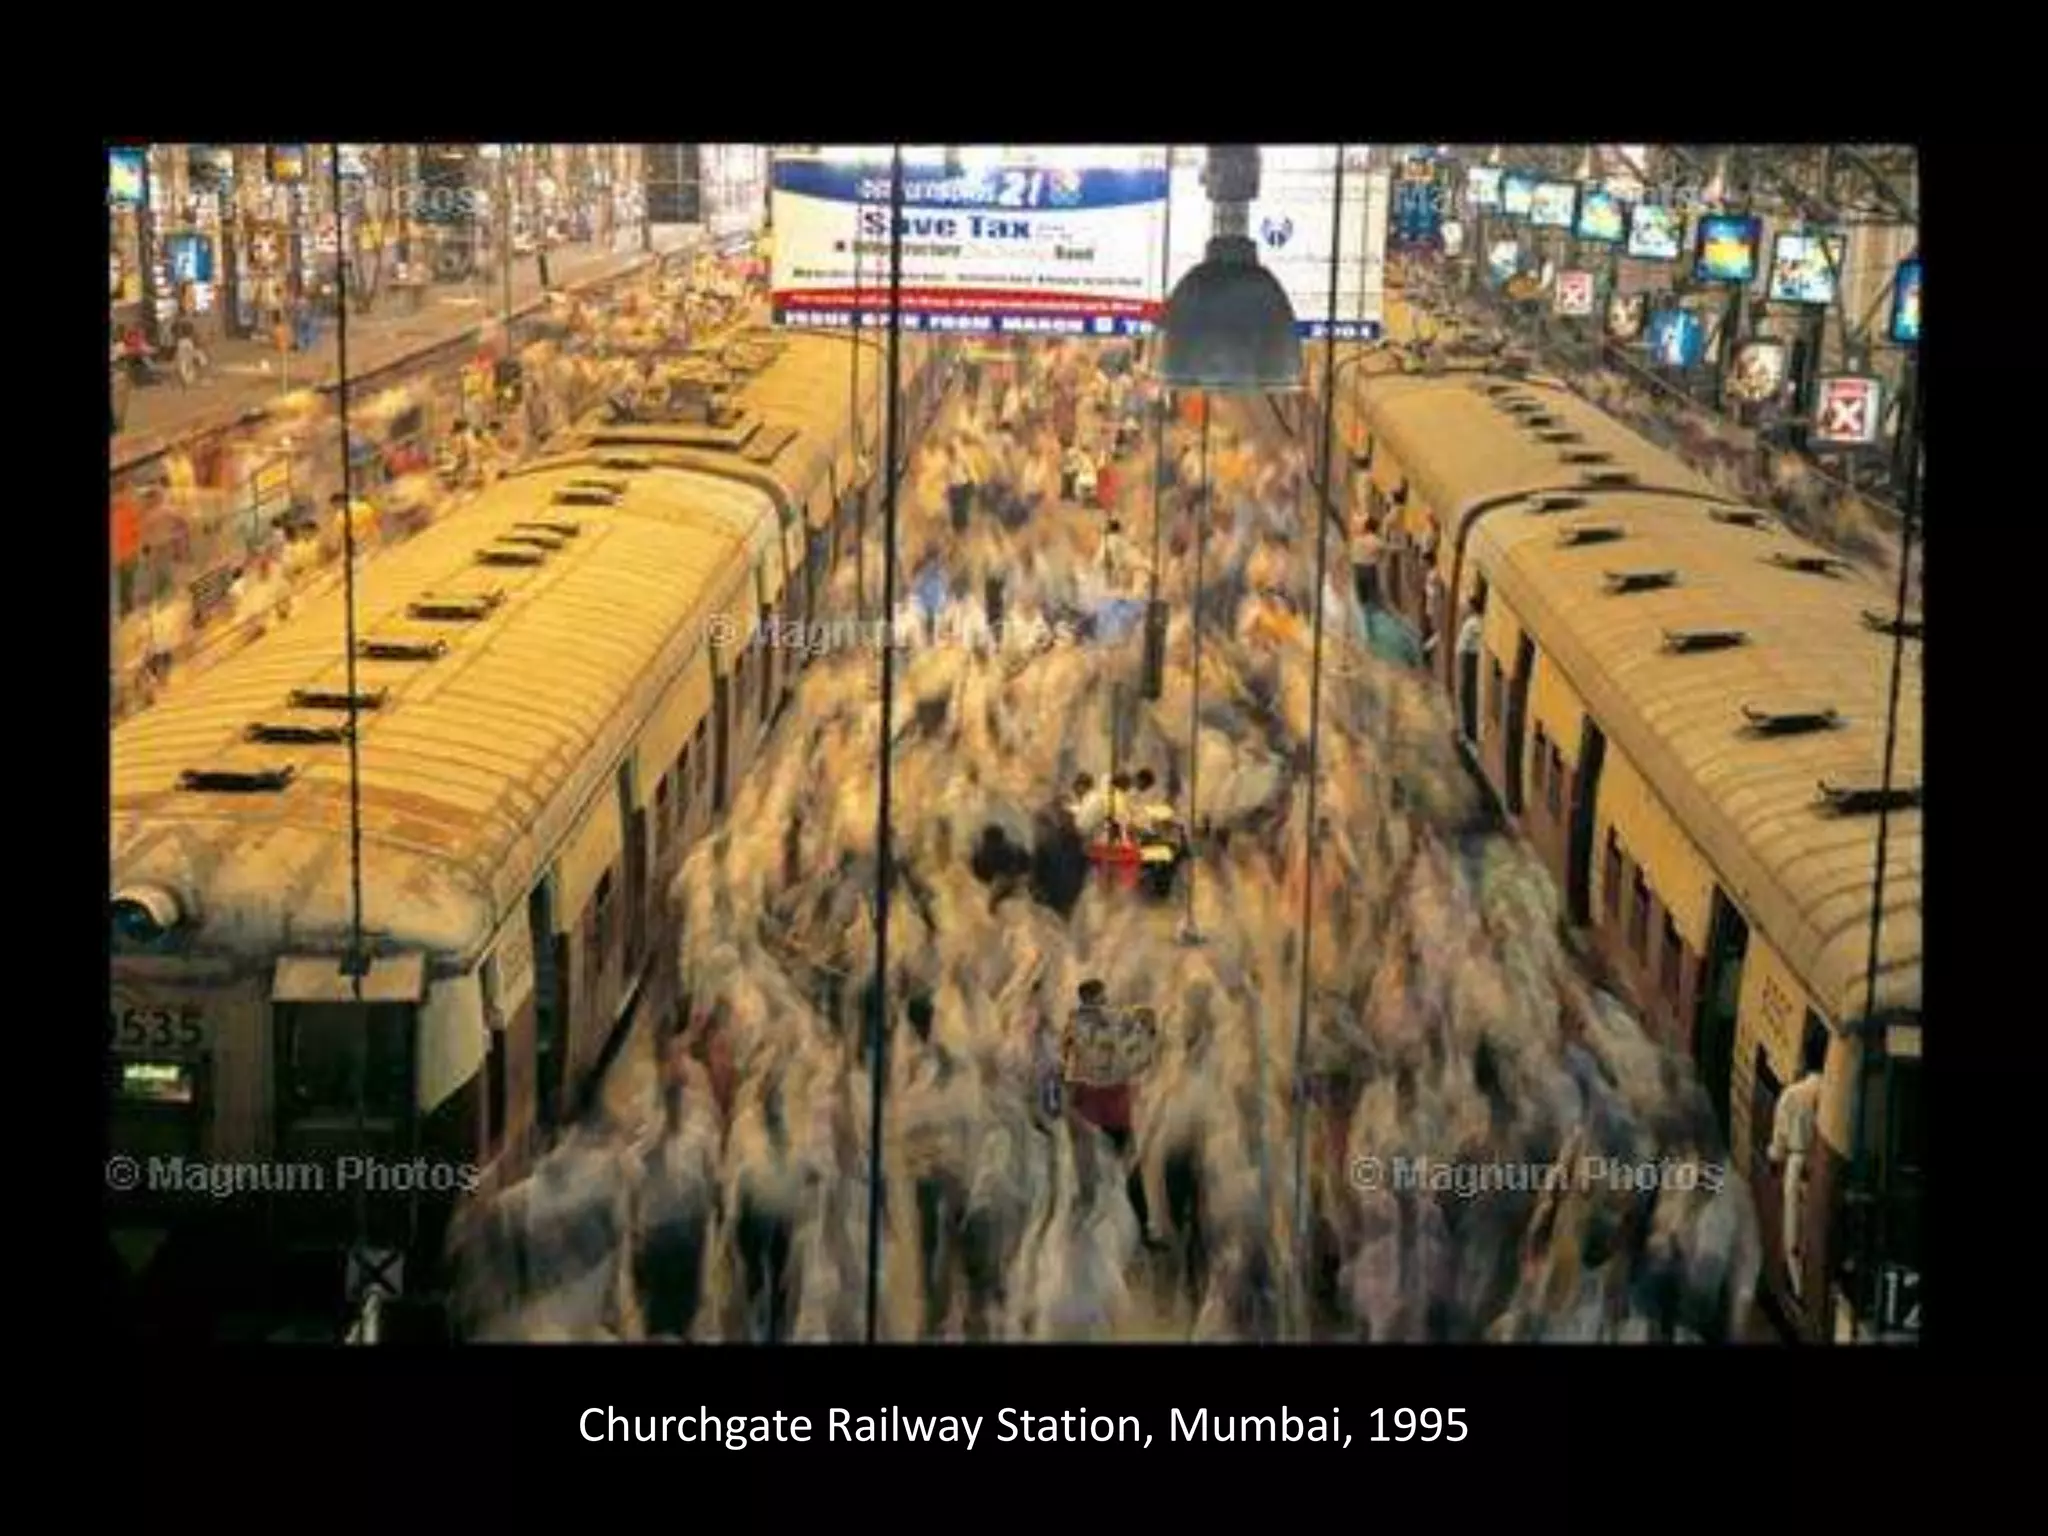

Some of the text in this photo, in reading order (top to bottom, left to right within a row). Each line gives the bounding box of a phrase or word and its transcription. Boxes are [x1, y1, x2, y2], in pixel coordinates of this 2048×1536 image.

[968, 215, 1029, 239] Tax
[860, 311, 920, 328] OPN
[929, 314, 992, 330] FROM
[1001, 315, 1084, 332] MARCH
